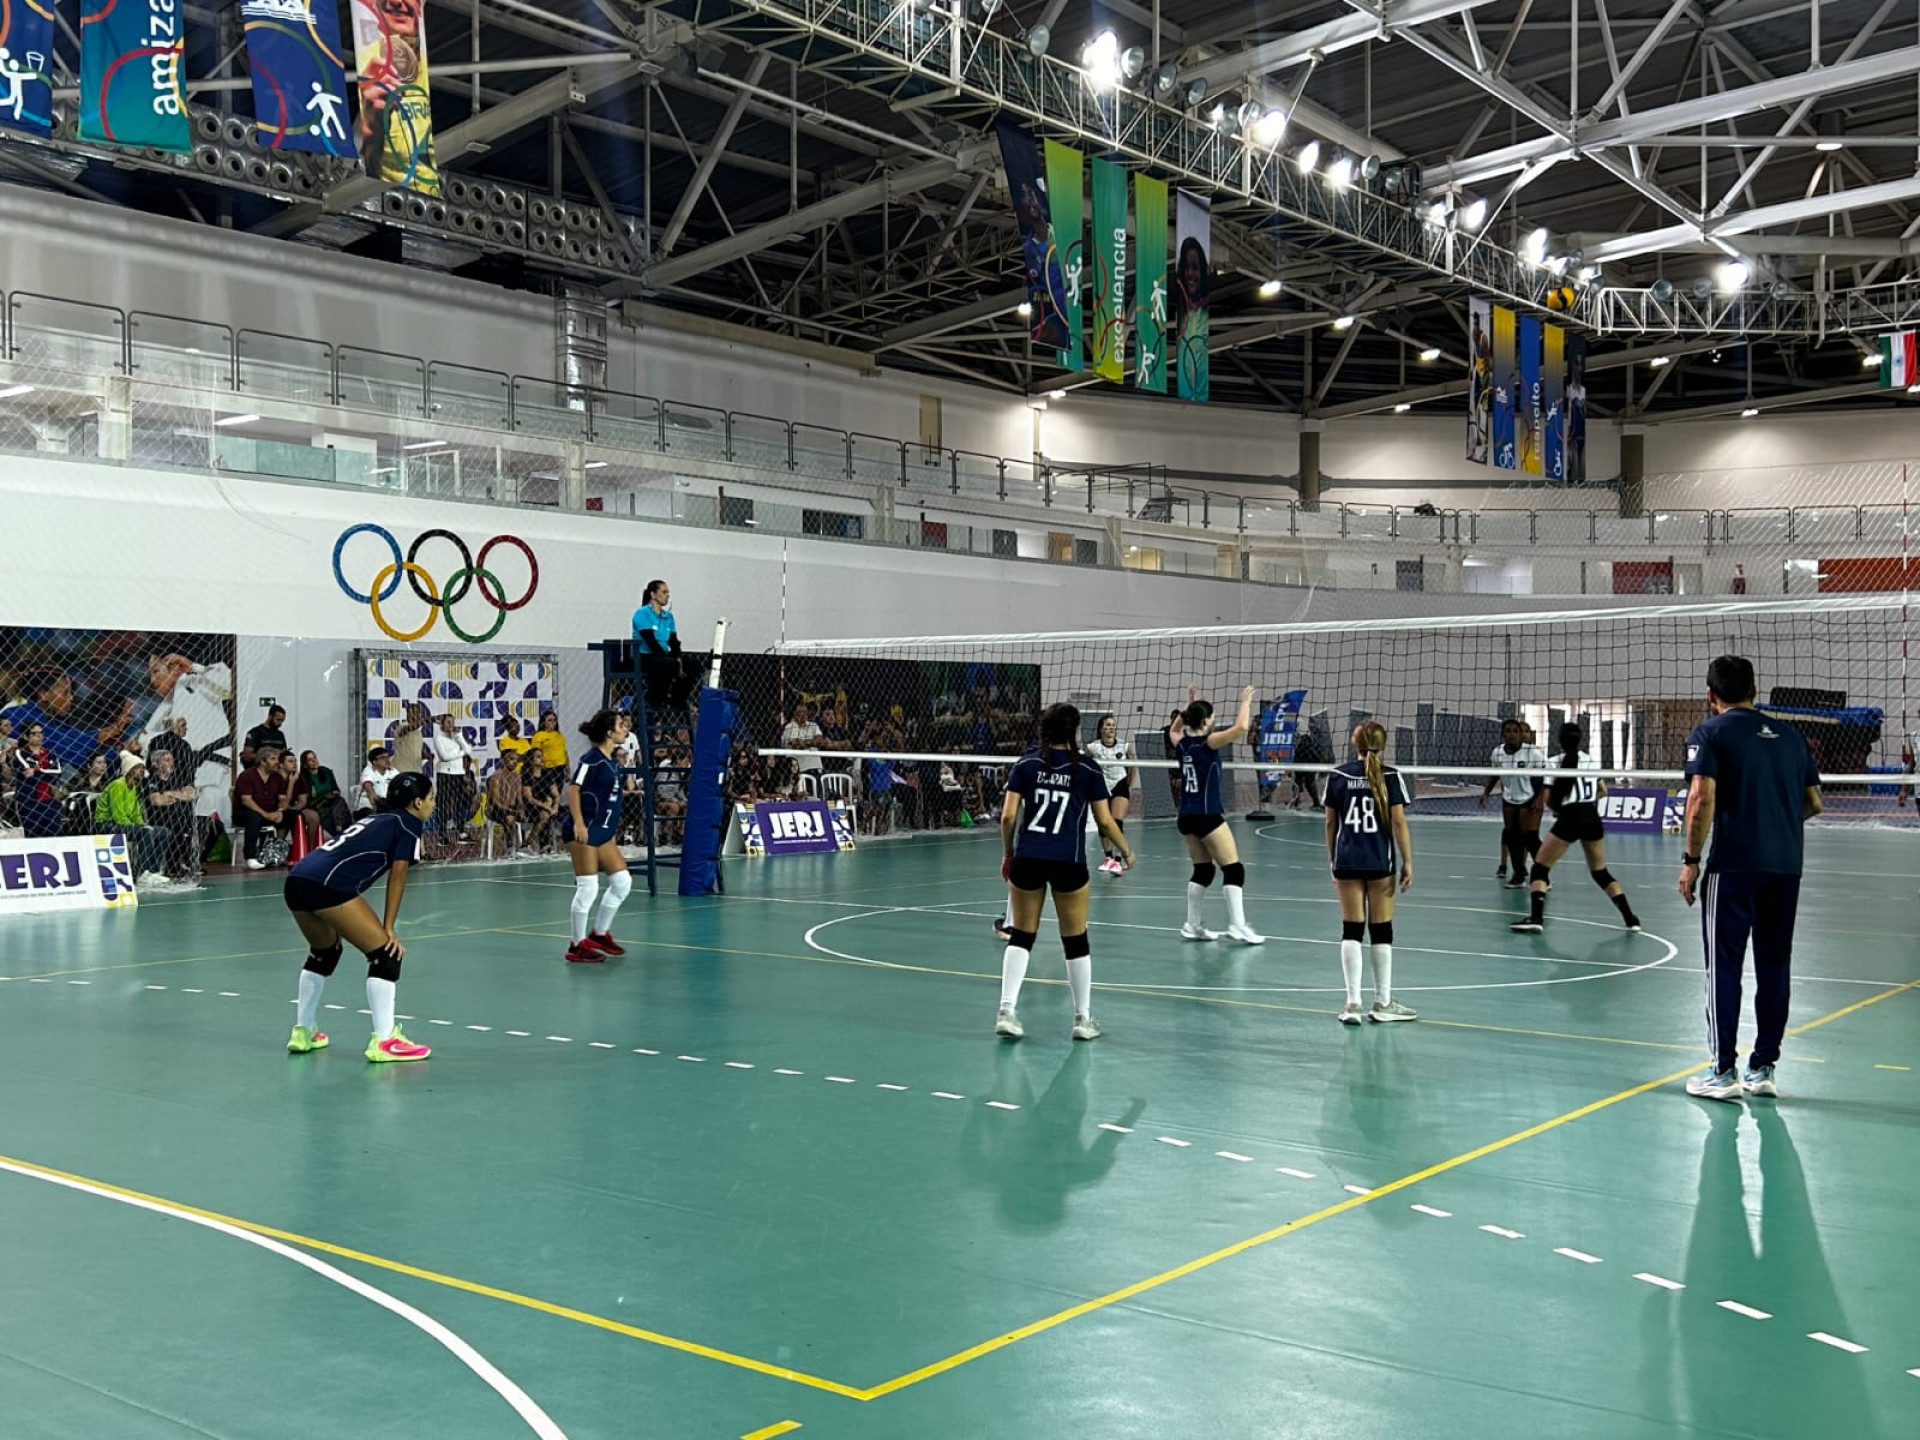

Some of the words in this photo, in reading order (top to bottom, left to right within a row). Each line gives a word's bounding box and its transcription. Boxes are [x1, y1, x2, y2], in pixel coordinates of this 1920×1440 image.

[768, 811, 825, 839] JERJ
[1027, 788, 1070, 835] 27
[1344, 796, 1378, 833] 48
[0, 851, 82, 890] ERJ
